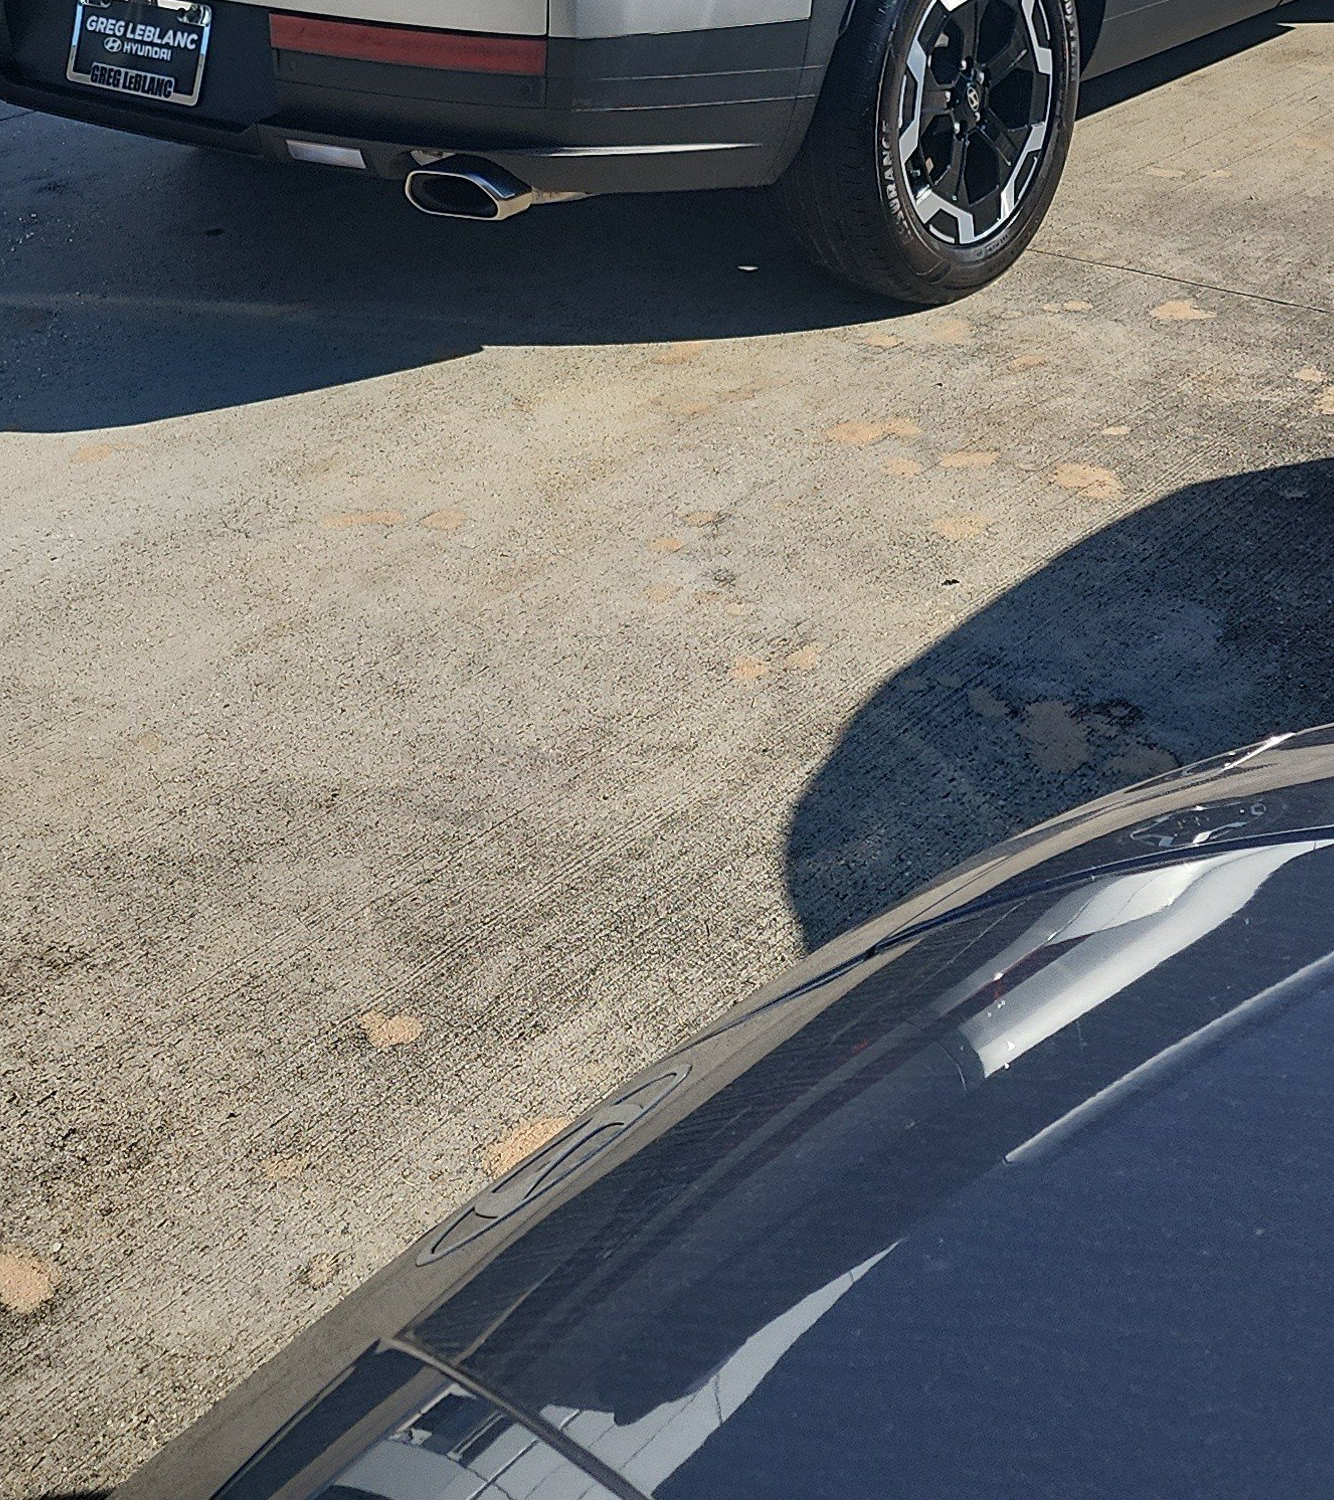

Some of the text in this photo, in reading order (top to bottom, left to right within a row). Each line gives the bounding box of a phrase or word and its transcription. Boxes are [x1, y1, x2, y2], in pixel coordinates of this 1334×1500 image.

[86, 15, 199, 50] GREG LEBLANC
[123, 41, 172, 61] HYUNDAI
[90, 64, 122, 88] GREG
